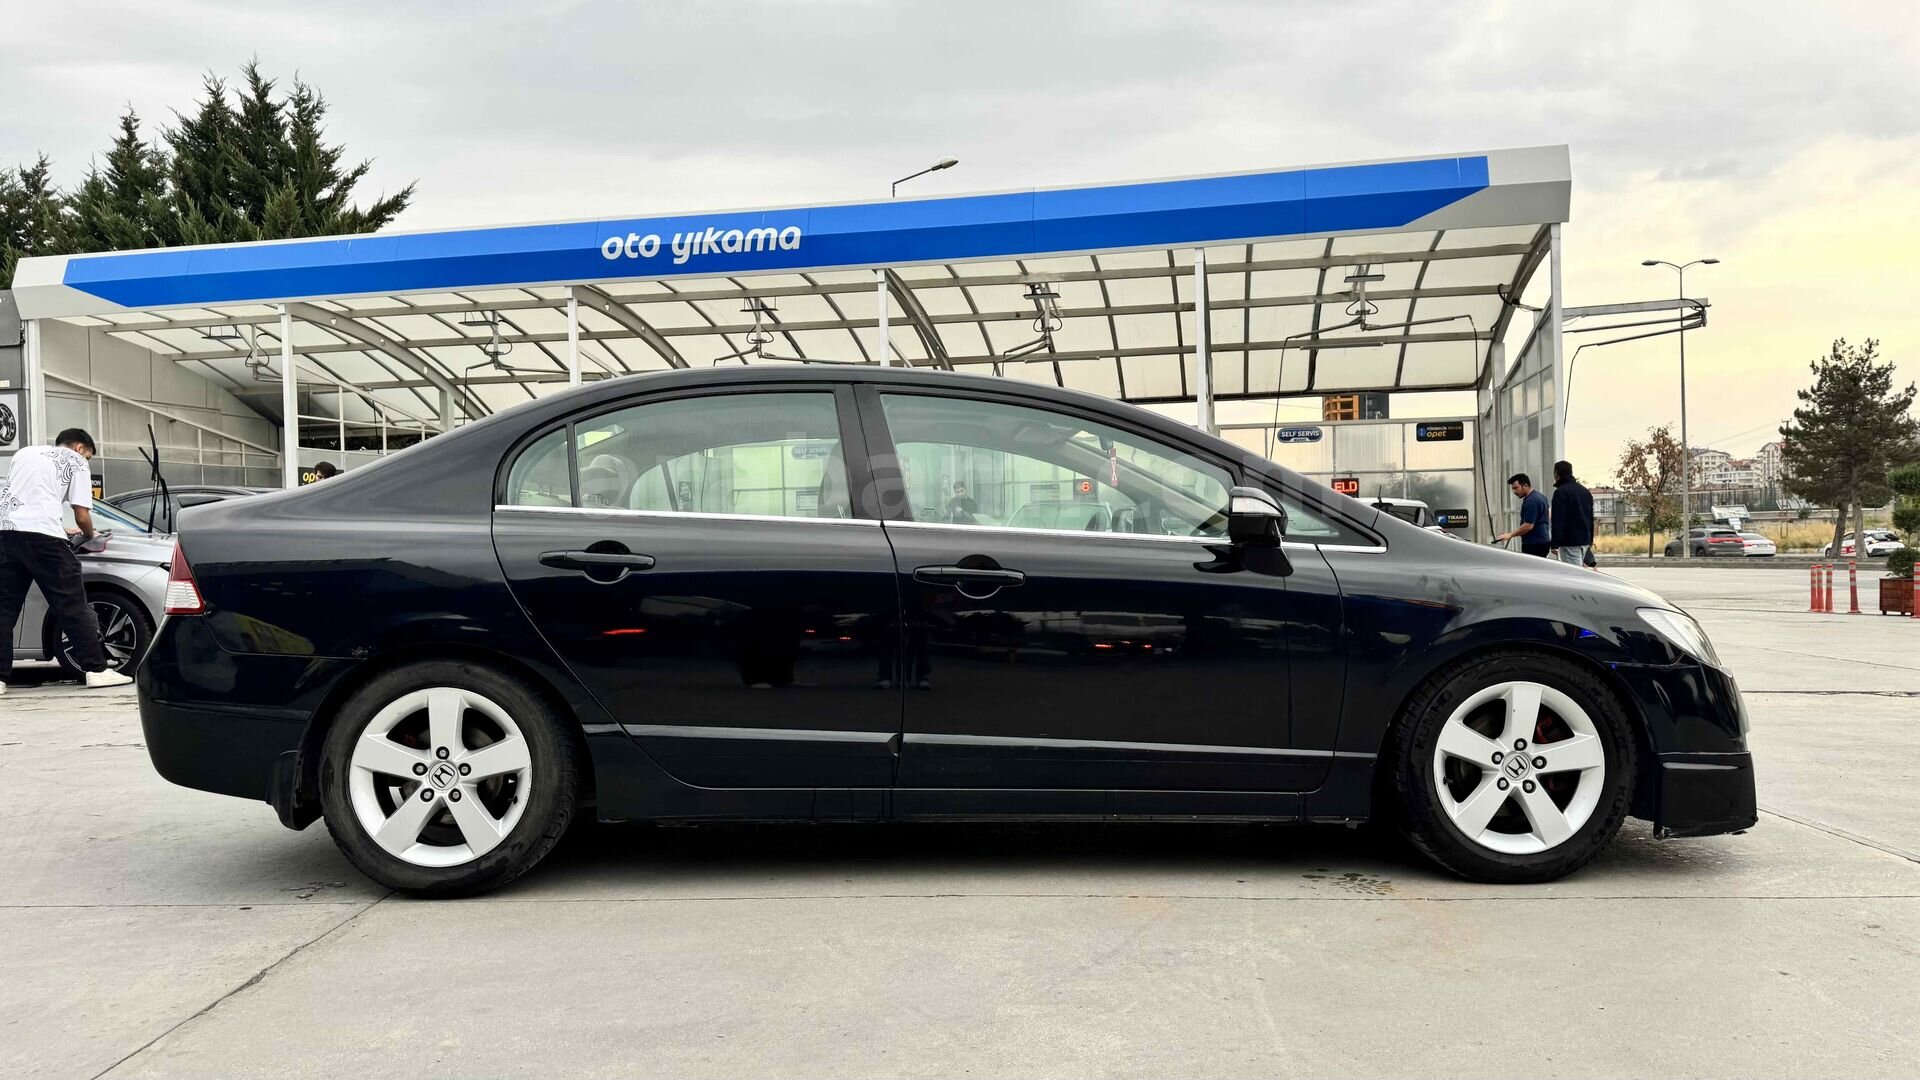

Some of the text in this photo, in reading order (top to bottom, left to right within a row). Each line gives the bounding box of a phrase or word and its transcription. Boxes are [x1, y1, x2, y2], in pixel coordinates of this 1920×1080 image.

[601, 226, 802, 265] oto yıkama
[1426, 430, 1447, 438] opet
[303, 472, 316, 484] op
[1335, 481, 1357, 492] ELD
